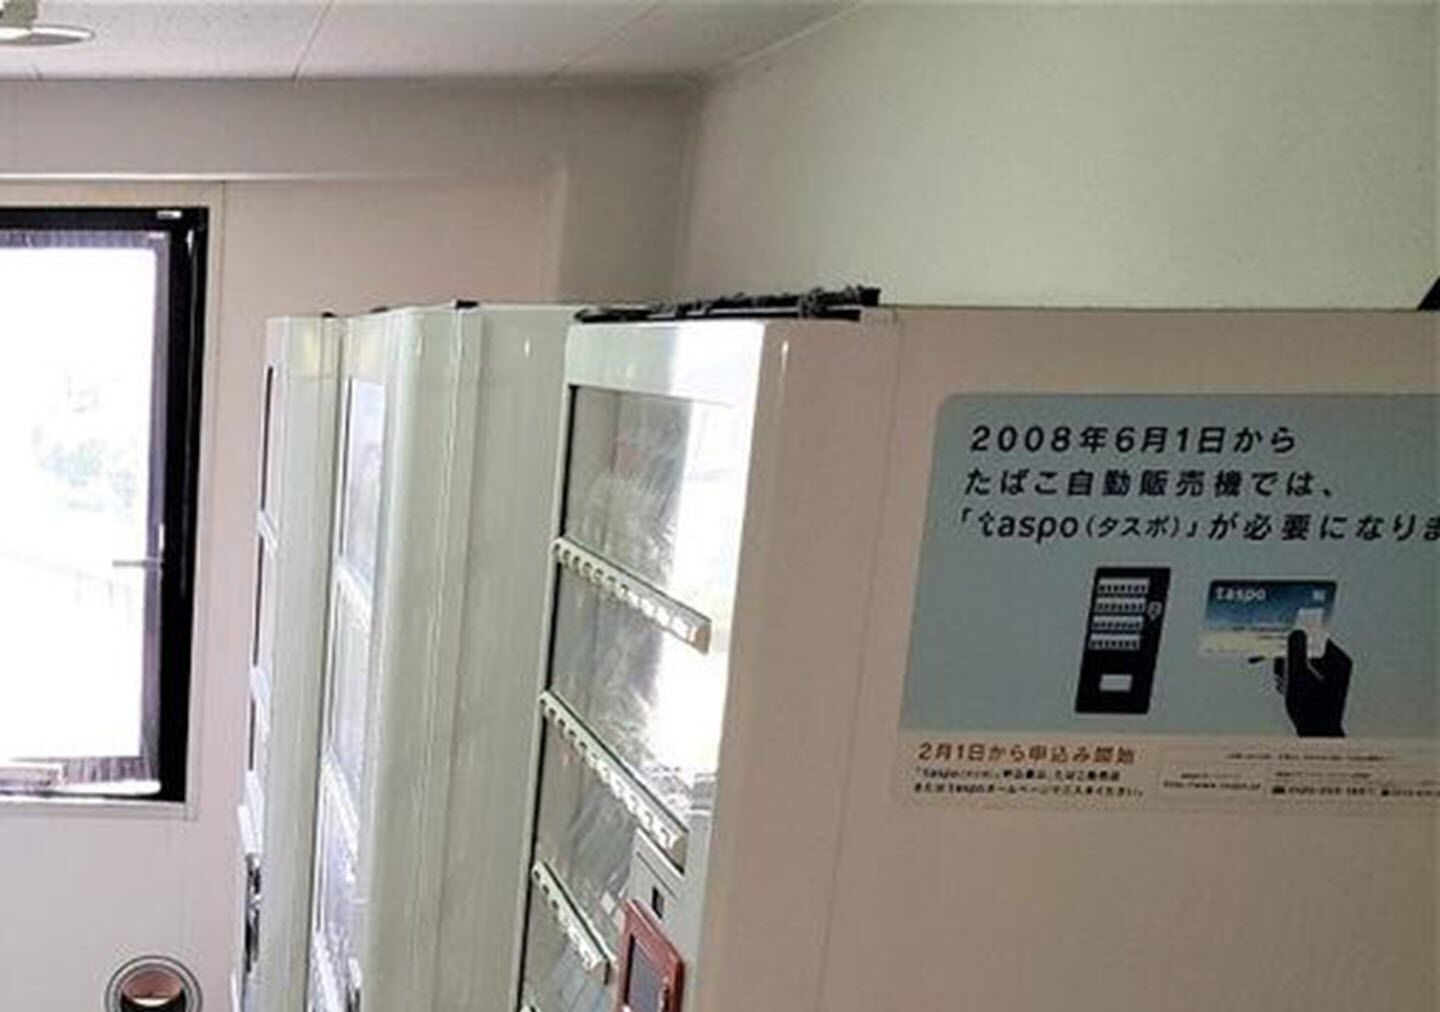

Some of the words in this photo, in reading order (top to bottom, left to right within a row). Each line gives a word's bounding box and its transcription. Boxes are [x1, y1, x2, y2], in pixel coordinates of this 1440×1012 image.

[970, 425, 1296, 454] 2008年6月1日から
[964, 467, 1332, 498] たばこ自動販売機では、
